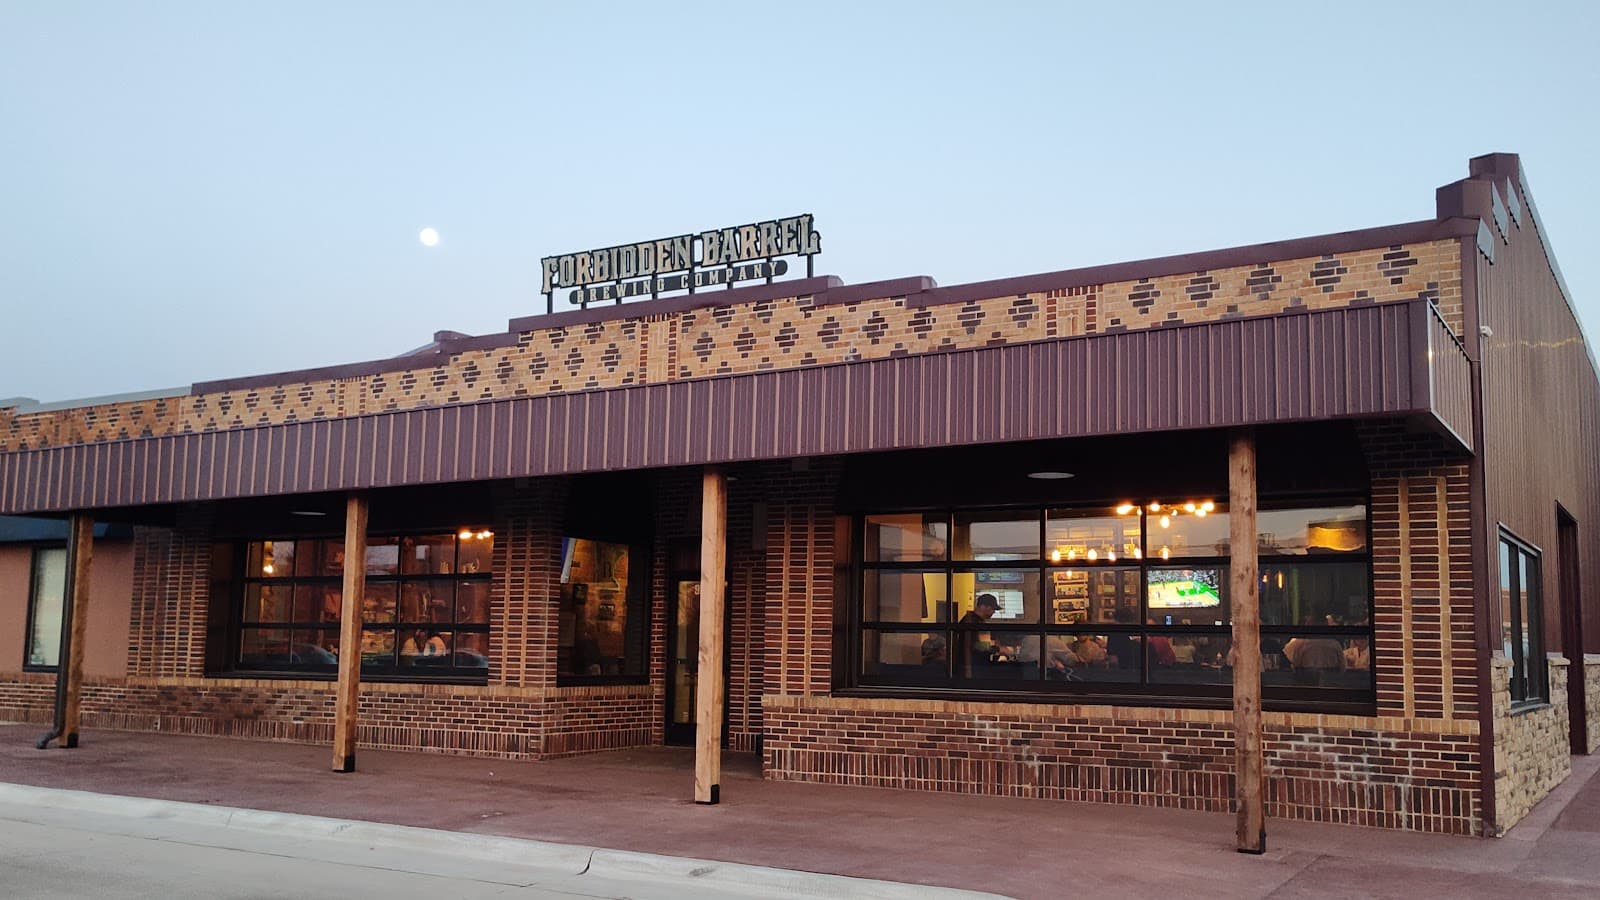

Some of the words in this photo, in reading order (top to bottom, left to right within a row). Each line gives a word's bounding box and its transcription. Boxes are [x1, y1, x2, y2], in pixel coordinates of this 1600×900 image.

[541, 234, 694, 294] FORBIDDEN
[700, 214, 821, 267] BARREL
[576, 278, 665, 303] BREWING
[680, 262, 778, 289] COMPANY
